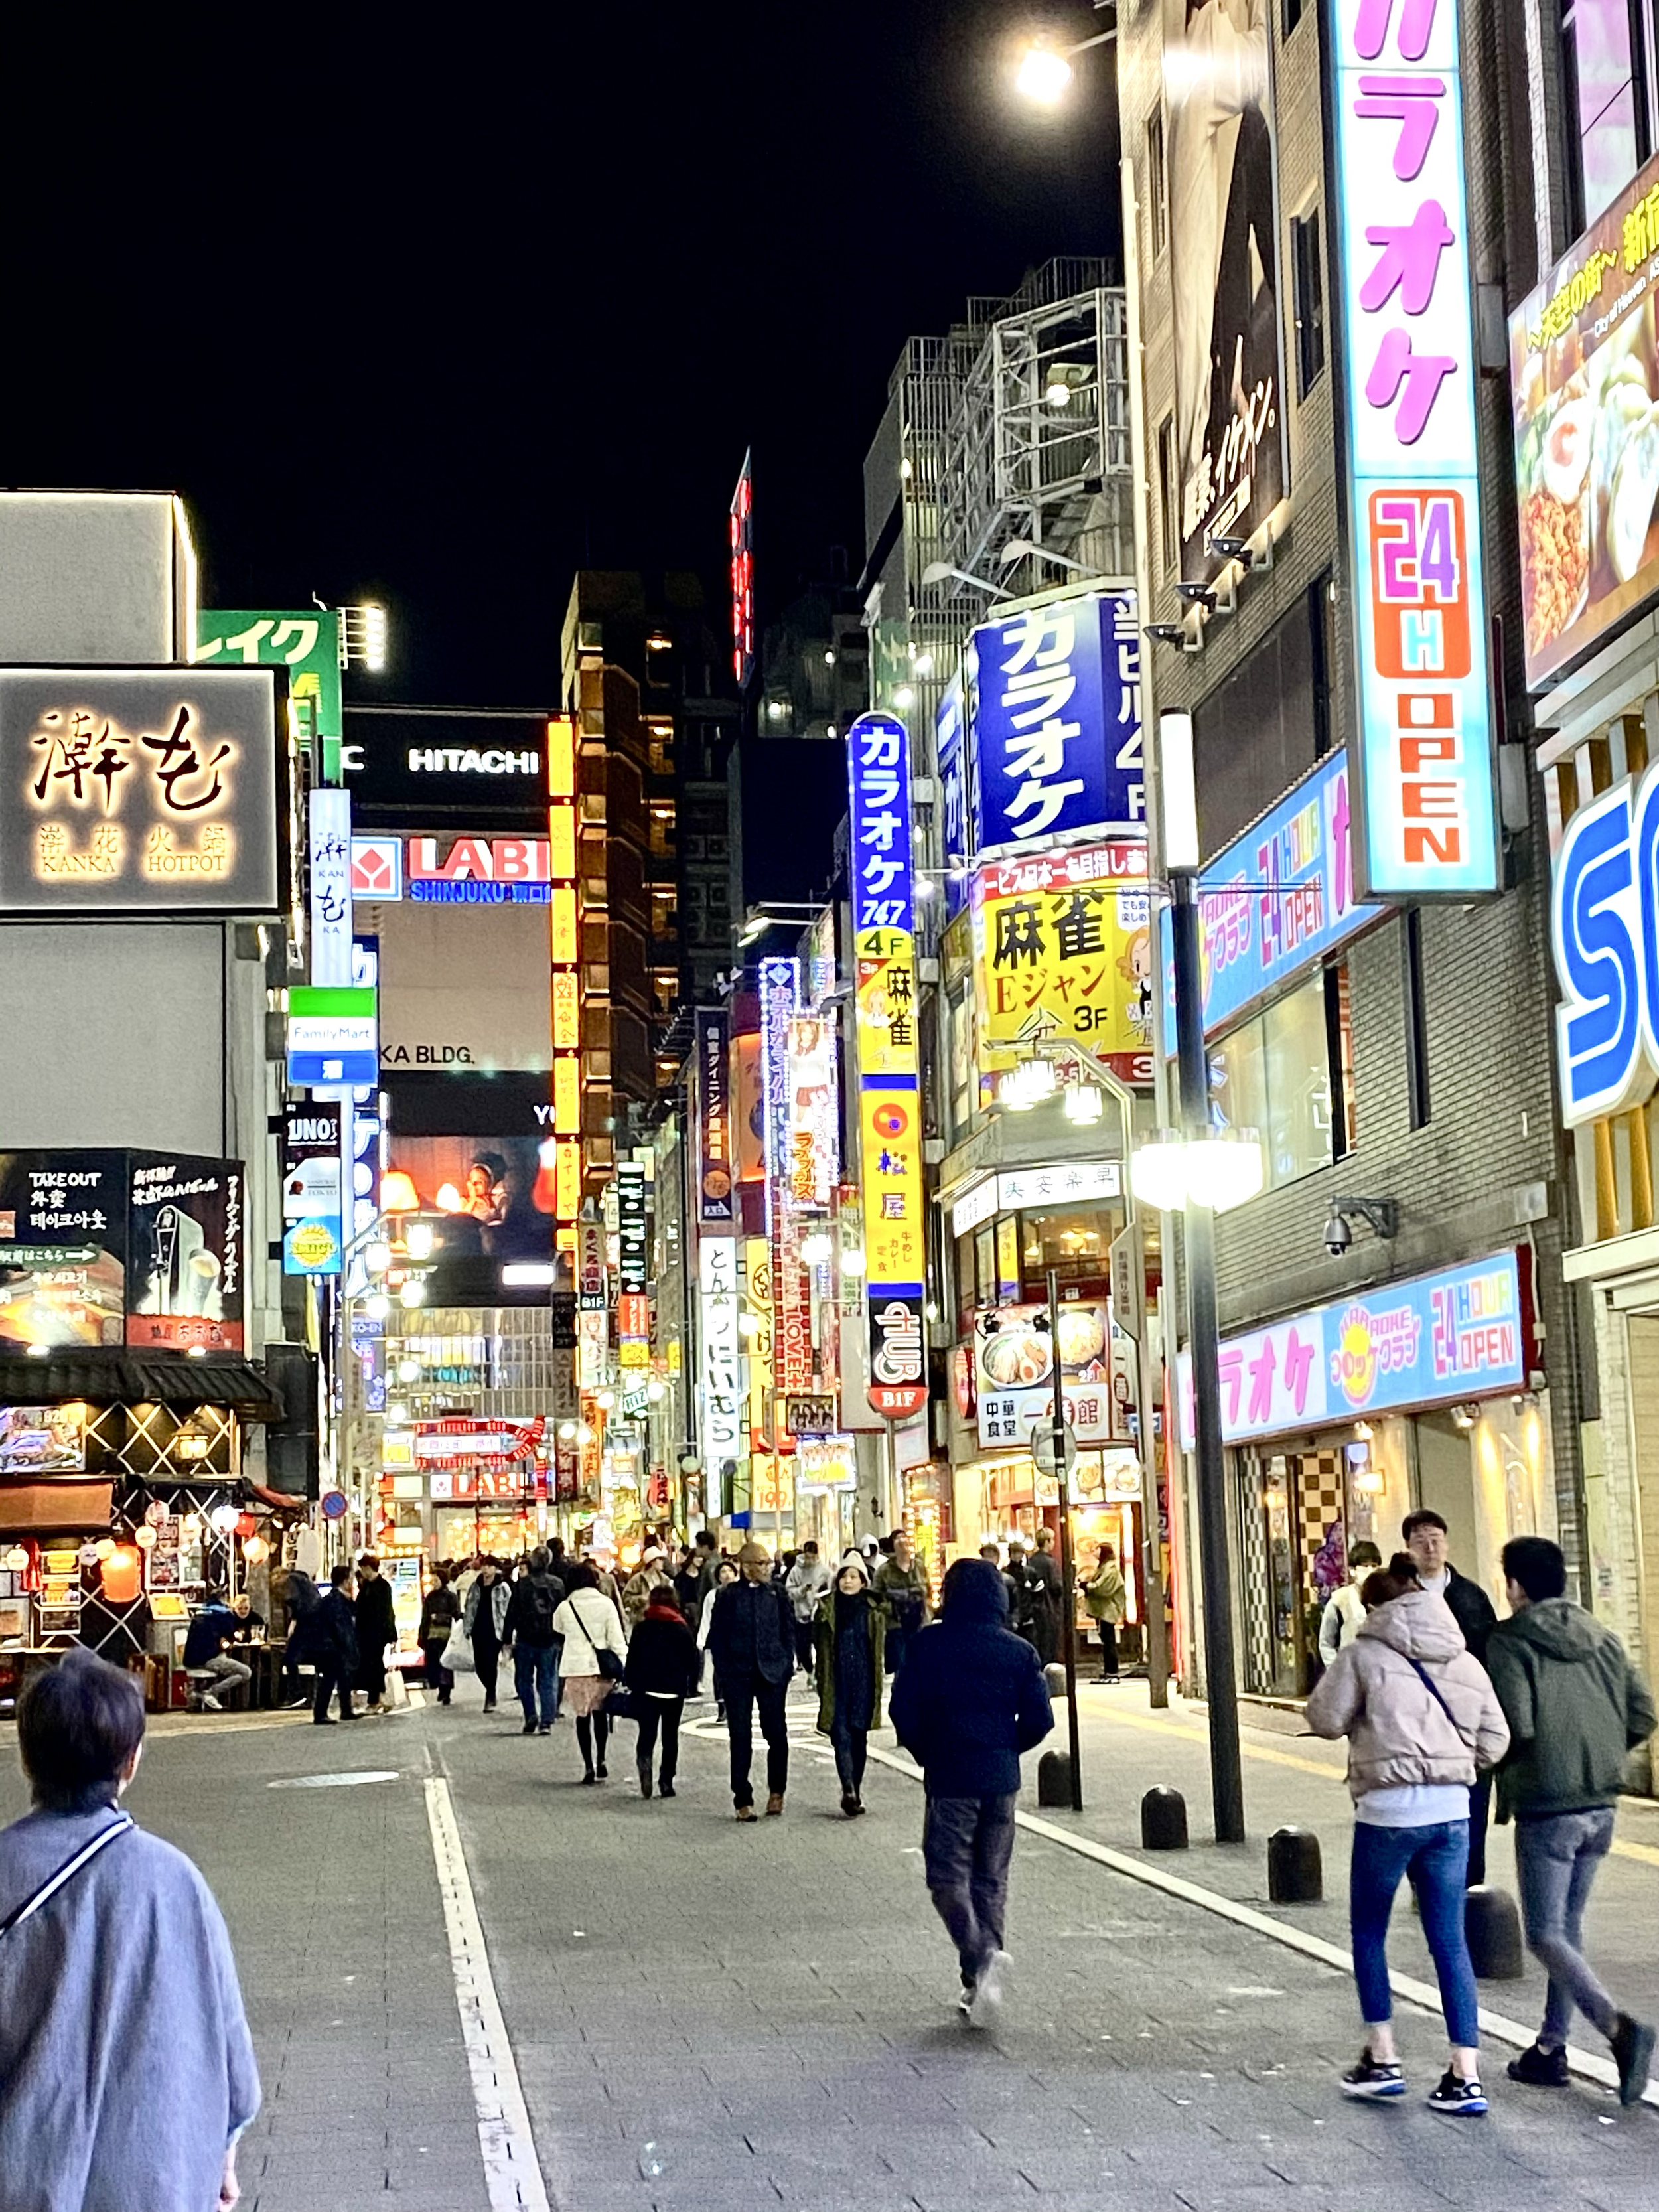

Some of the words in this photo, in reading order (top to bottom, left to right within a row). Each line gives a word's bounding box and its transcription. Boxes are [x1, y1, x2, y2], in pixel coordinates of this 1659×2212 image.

[1000, 613, 1084, 838] カラオケ
[409, 749, 540, 774] HITACHI
[1397, 693, 1461, 863] OPEN
[859, 727, 905, 895] カラオケ
[149, 827, 226, 854] 火鍋
[1281, 796, 1321, 881] HOUR
[42, 855, 117, 873] KANKA
[148, 855, 224, 873] HOTPOT
[409, 836, 551, 882] LABI
[410, 881, 506, 903] SHINJUKU
[861, 899, 906, 926] 747
[1284, 869, 1323, 952] OPEN
[863, 930, 905, 957] 4F
[993, 889, 1106, 972] 麻雀
[861, 962, 879, 974] 3F
[994, 965, 1106, 1015] Eジャン
[886, 966, 913, 1047] 麻雀
[1074, 1004, 1108, 1033] 3F
[293, 1026, 370, 1041] FamilyMart
[415, 1045, 476, 1065] BLDG.
[876, 1147, 908, 1220] 松屋
[29, 1209, 108, 1230] 테이크아웃
[877, 1245, 887, 1272] 定食
[889, 1238, 899, 1269] カレー
[901, 1231, 913, 1264] 牛めし
[1430, 1283, 1457, 1380] 24
[1457, 1268, 1514, 1325] HOUR
[874, 1301, 922, 1385] HUB
[1459, 1322, 1515, 1371] OPEN
[1187, 1326, 1315, 1438] ラオケ
[881, 1391, 916, 1408] B1F
[986, 1400, 1016, 1418] 中華
[987, 1420, 1017, 1438] 食堂
